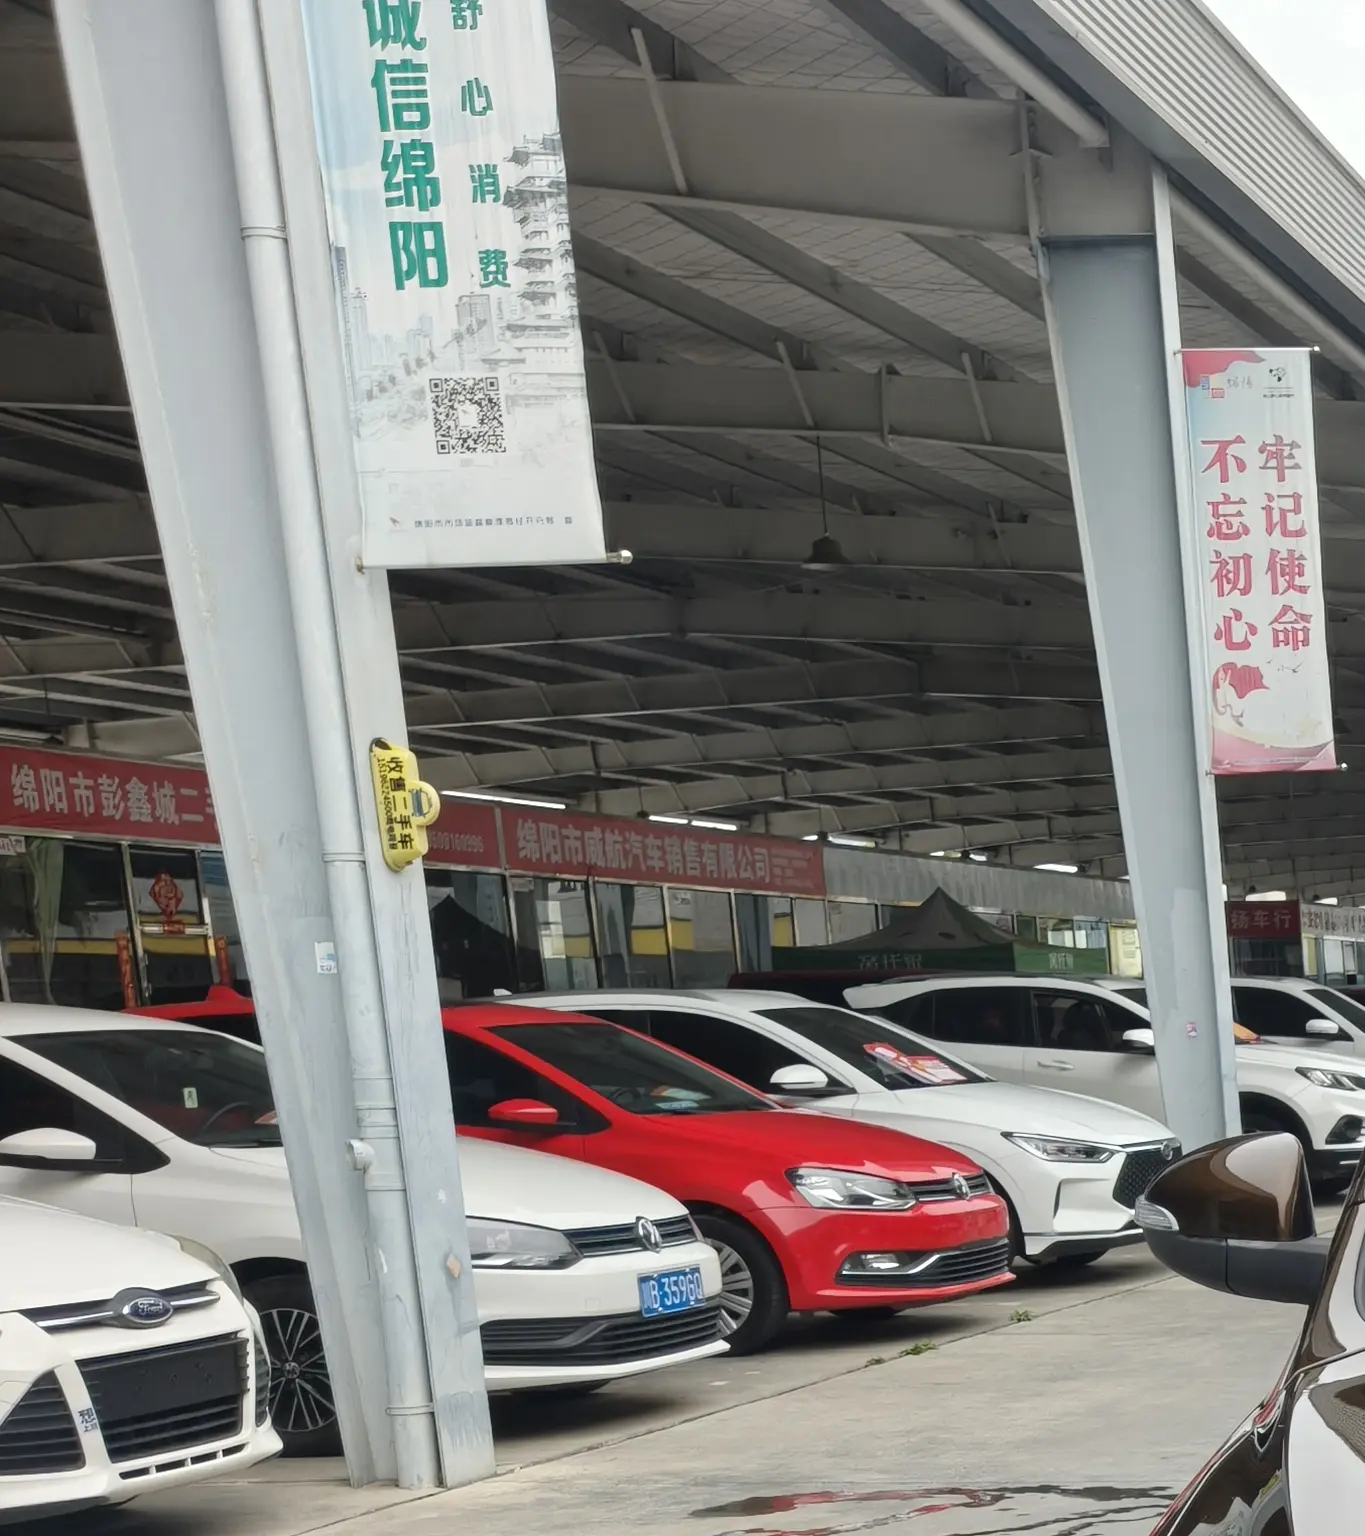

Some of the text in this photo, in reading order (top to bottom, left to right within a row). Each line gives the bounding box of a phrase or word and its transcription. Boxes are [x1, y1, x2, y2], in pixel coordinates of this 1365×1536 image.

[362, 0, 449, 290] 诚信绵阳
[450, 0, 511, 289] 舒心消费
[1201, 435, 1257, 652] 不忘初心
[1258, 434, 1313, 652] 牢记使命
[387, 757, 414, 850] 收售二手车
